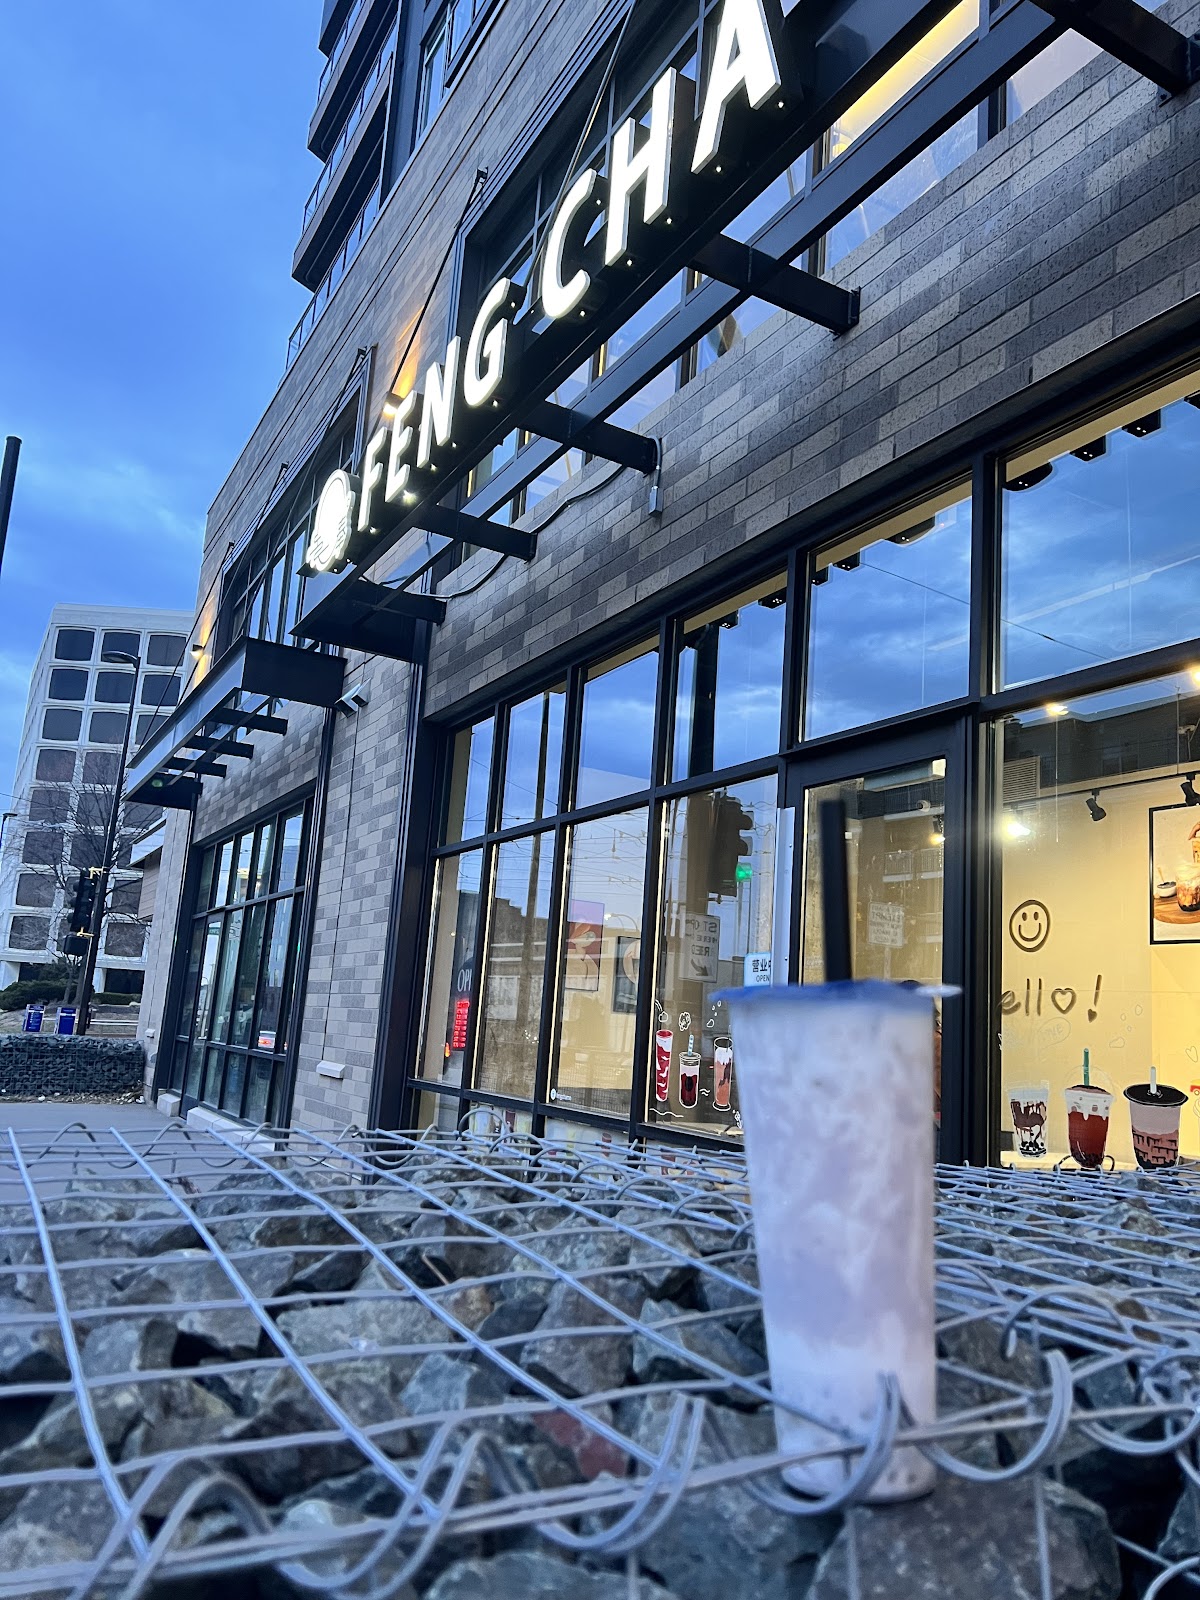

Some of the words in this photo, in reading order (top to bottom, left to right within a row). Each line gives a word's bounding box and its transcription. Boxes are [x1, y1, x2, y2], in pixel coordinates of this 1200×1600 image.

[357, 277, 510, 532] FENG
[542, 0, 781, 317] CHA
[756, 975, 769, 983] OPEN
